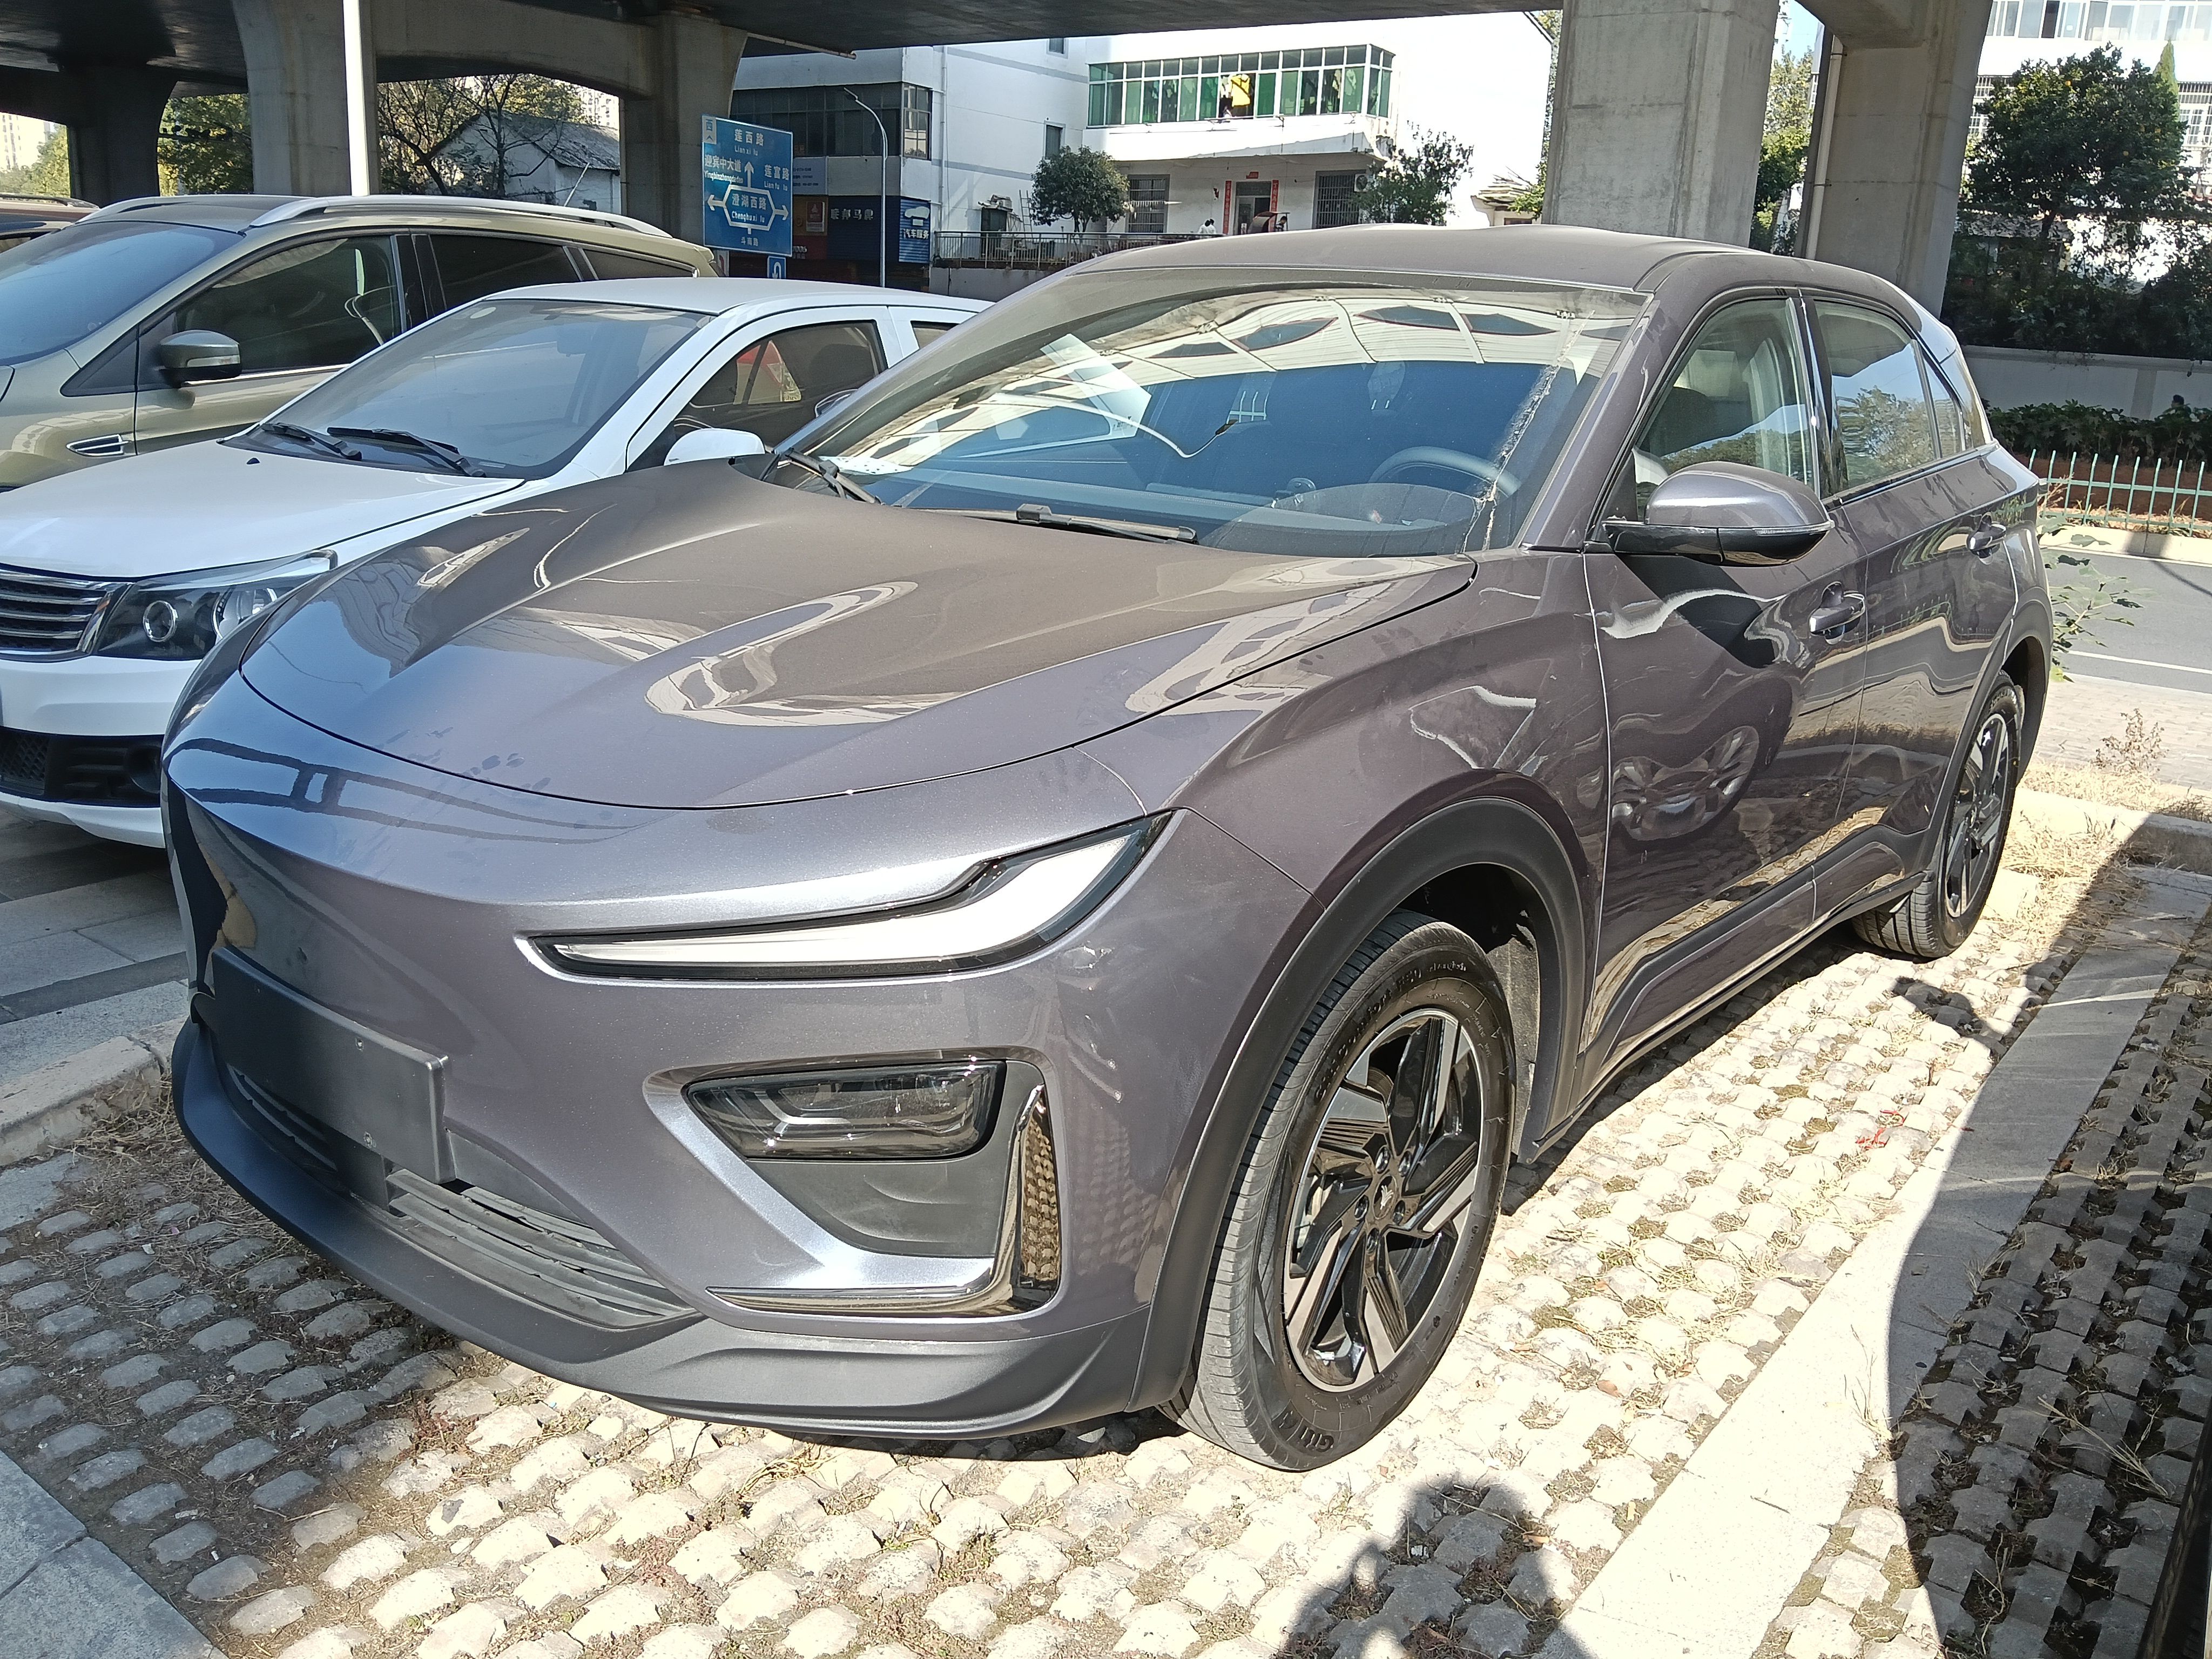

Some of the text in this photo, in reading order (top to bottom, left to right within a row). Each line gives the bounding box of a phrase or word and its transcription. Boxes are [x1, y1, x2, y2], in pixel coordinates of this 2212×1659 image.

[706, 119, 713, 131] 西
[734, 129, 764, 146] 莲西路
[704, 154, 741, 173] 迎宾中大道
[764, 164, 790, 181] 莲富路
[732, 193, 766, 210] 澄湖西路
[903, 228, 929, 239] 汽车服务
